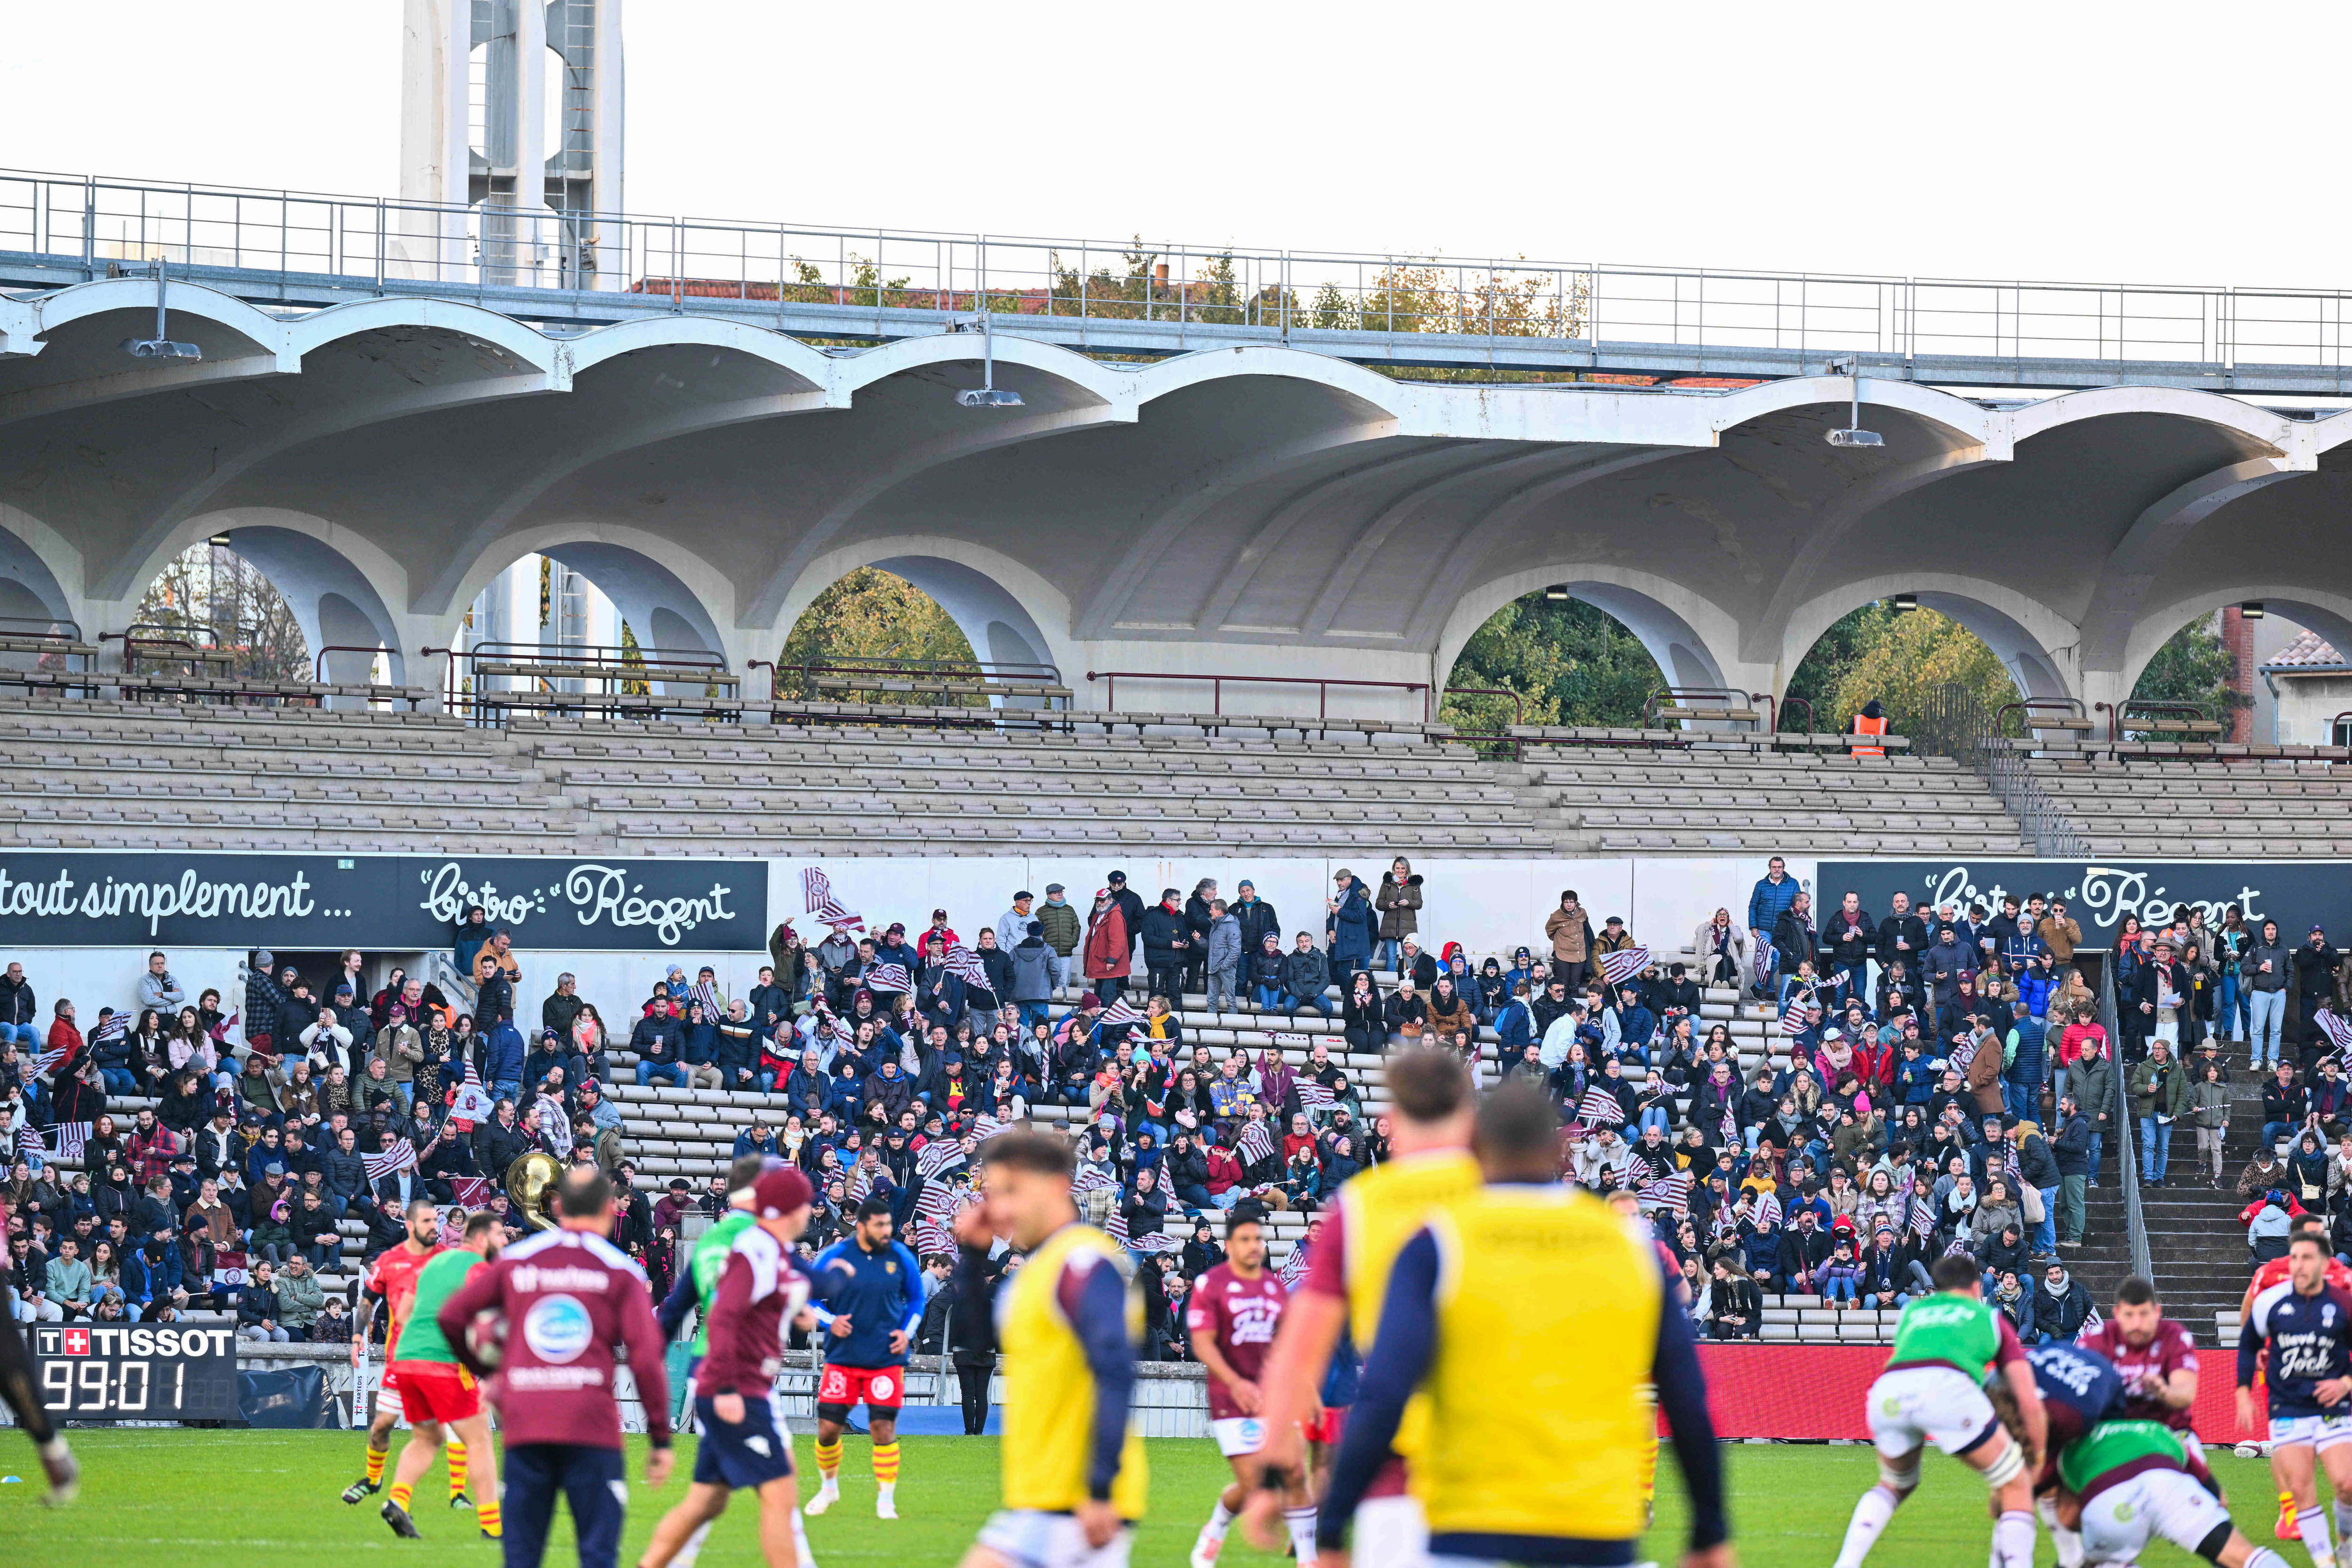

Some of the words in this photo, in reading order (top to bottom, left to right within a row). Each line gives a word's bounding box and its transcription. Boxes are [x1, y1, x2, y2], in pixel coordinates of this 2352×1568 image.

[0, 869, 78, 916] tout
[81, 869, 315, 936] simplement
[92, 1329, 233, 1356] TISSOT
[2279, 1346, 2335, 1381] Jock
[43, 1361, 184, 1410] 99:01
